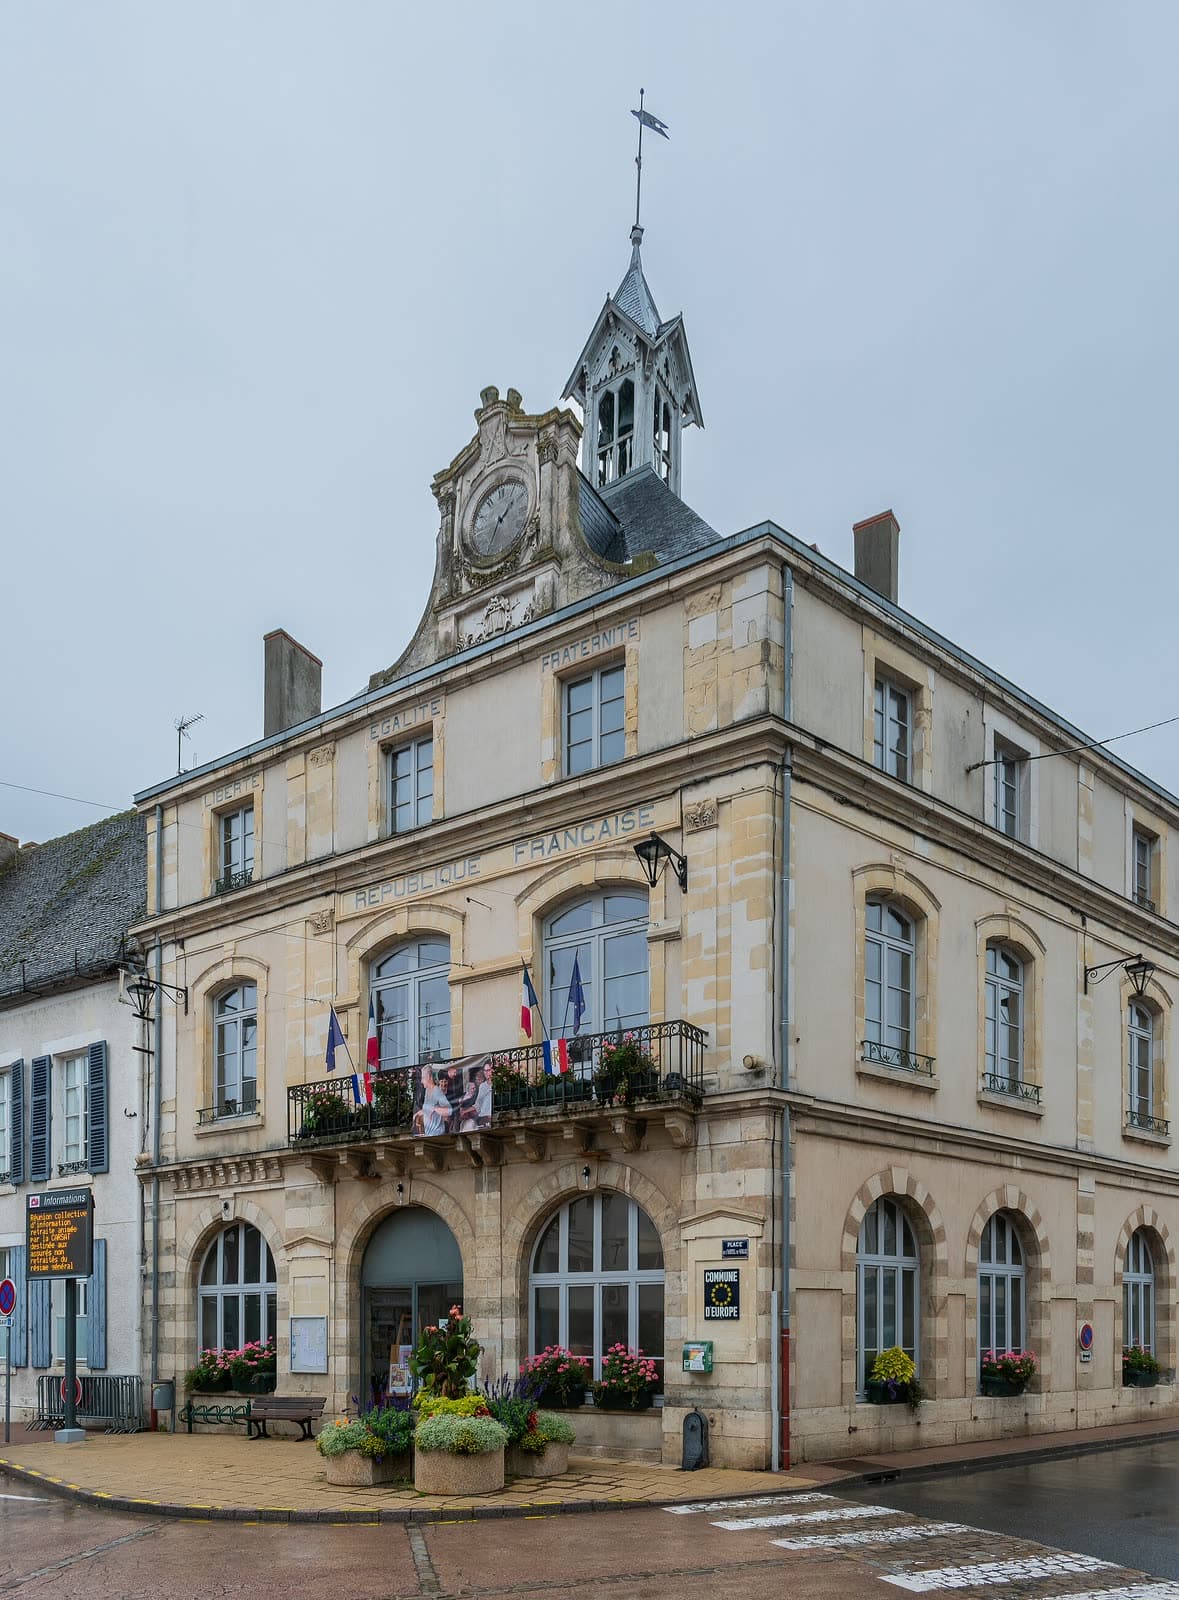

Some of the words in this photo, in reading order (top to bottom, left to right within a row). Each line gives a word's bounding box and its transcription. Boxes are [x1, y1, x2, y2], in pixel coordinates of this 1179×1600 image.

[541, 619, 638, 673] FRATERNITE
[370, 699, 441, 740] EGALITE
[354, 856, 481, 910] REPUBLIQUE
[44, 1194, 86, 1205] Informations
[705, 1271, 738, 1282] COMMUNE
[705, 1306, 738, 1317] D'EUROPE
